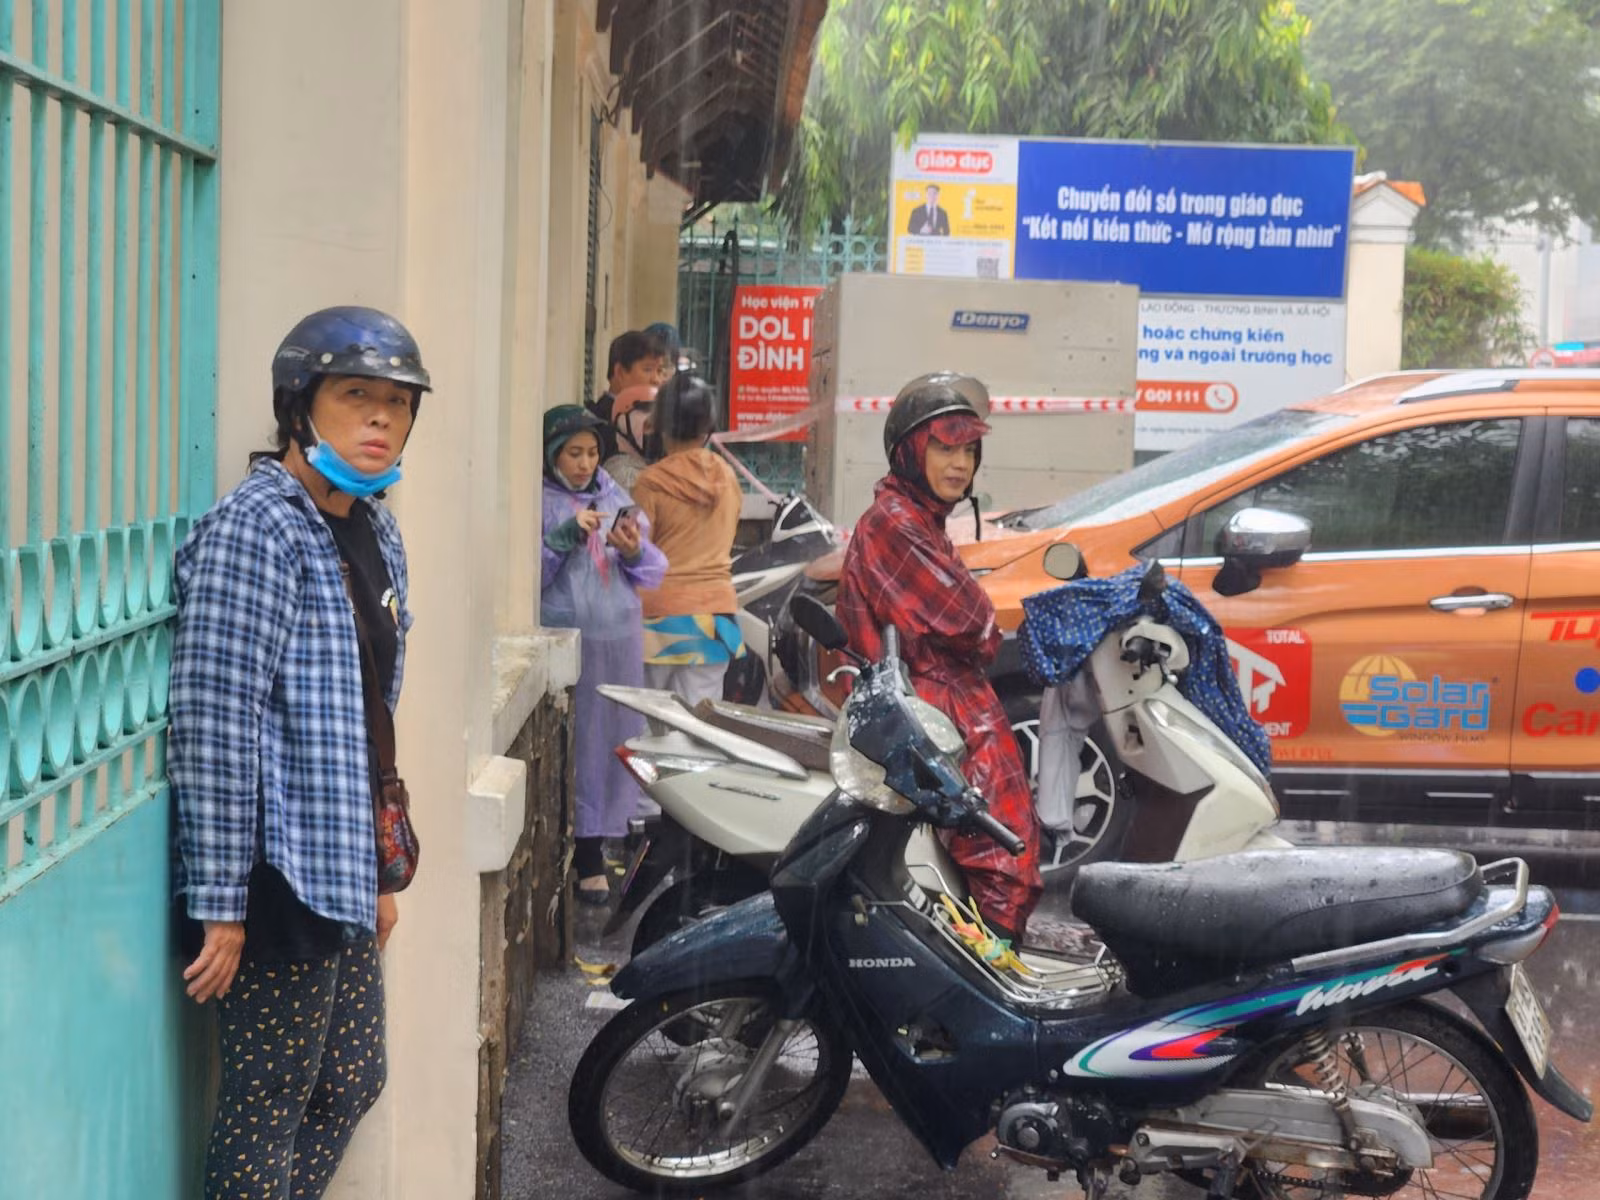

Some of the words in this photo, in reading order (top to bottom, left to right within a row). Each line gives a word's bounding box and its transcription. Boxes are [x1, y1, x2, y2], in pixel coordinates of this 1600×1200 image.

[918, 149, 957, 172] giáo
[1057, 183, 1121, 213] Chuyển
[1155, 187, 1177, 214] số
[1180, 192, 1226, 218] trong
[1229, 192, 1267, 218] giáo
[1271, 192, 1304, 220] dục
[1061, 214, 1089, 241] nối
[1092, 216, 1130, 243] kiến
[1134, 220, 1172, 244] thức
[1186, 220, 1213, 245] Mở
[1216, 222, 1256, 250] rộng
[1259, 219, 1292, 247] tầm
[741, 295, 768, 311] Học
[771, 295, 798, 311] viện
[1141, 303, 1160, 313] LAO
[1164, 302, 1195, 314] ĐỘNG
[1204, 303, 1251, 316] THƯƠNG
[1253, 305, 1279, 316] BINH
[1281, 304, 1293, 316] VÀ
[1297, 304, 1310, 316] XÃ
[1312, 305, 1331, 317] HỘI
[739, 315, 796, 341] DOL
[960, 311, 1021, 329] Denyo
[1143, 325, 1185, 341] hoặc
[1190, 326, 1243, 345] chứng
[1247, 327, 1285, 343] kiến
[737, 340, 804, 371] ĐÌNH
[1164, 347, 1184, 360] và
[1189, 346, 1236, 364] ngoài
[1241, 349, 1297, 367] trường
[1302, 349, 1333, 366] học
[1175, 389, 1200, 404] 111
[1266, 629, 1305, 645] TOTAL
[1369, 674, 1491, 704] Solar
[1378, 693, 1491, 731] Gard
[1399, 734, 1450, 743] WINDOW
[1455, 734, 1486, 744] FILMS
[848, 956, 916, 968] HONDA
